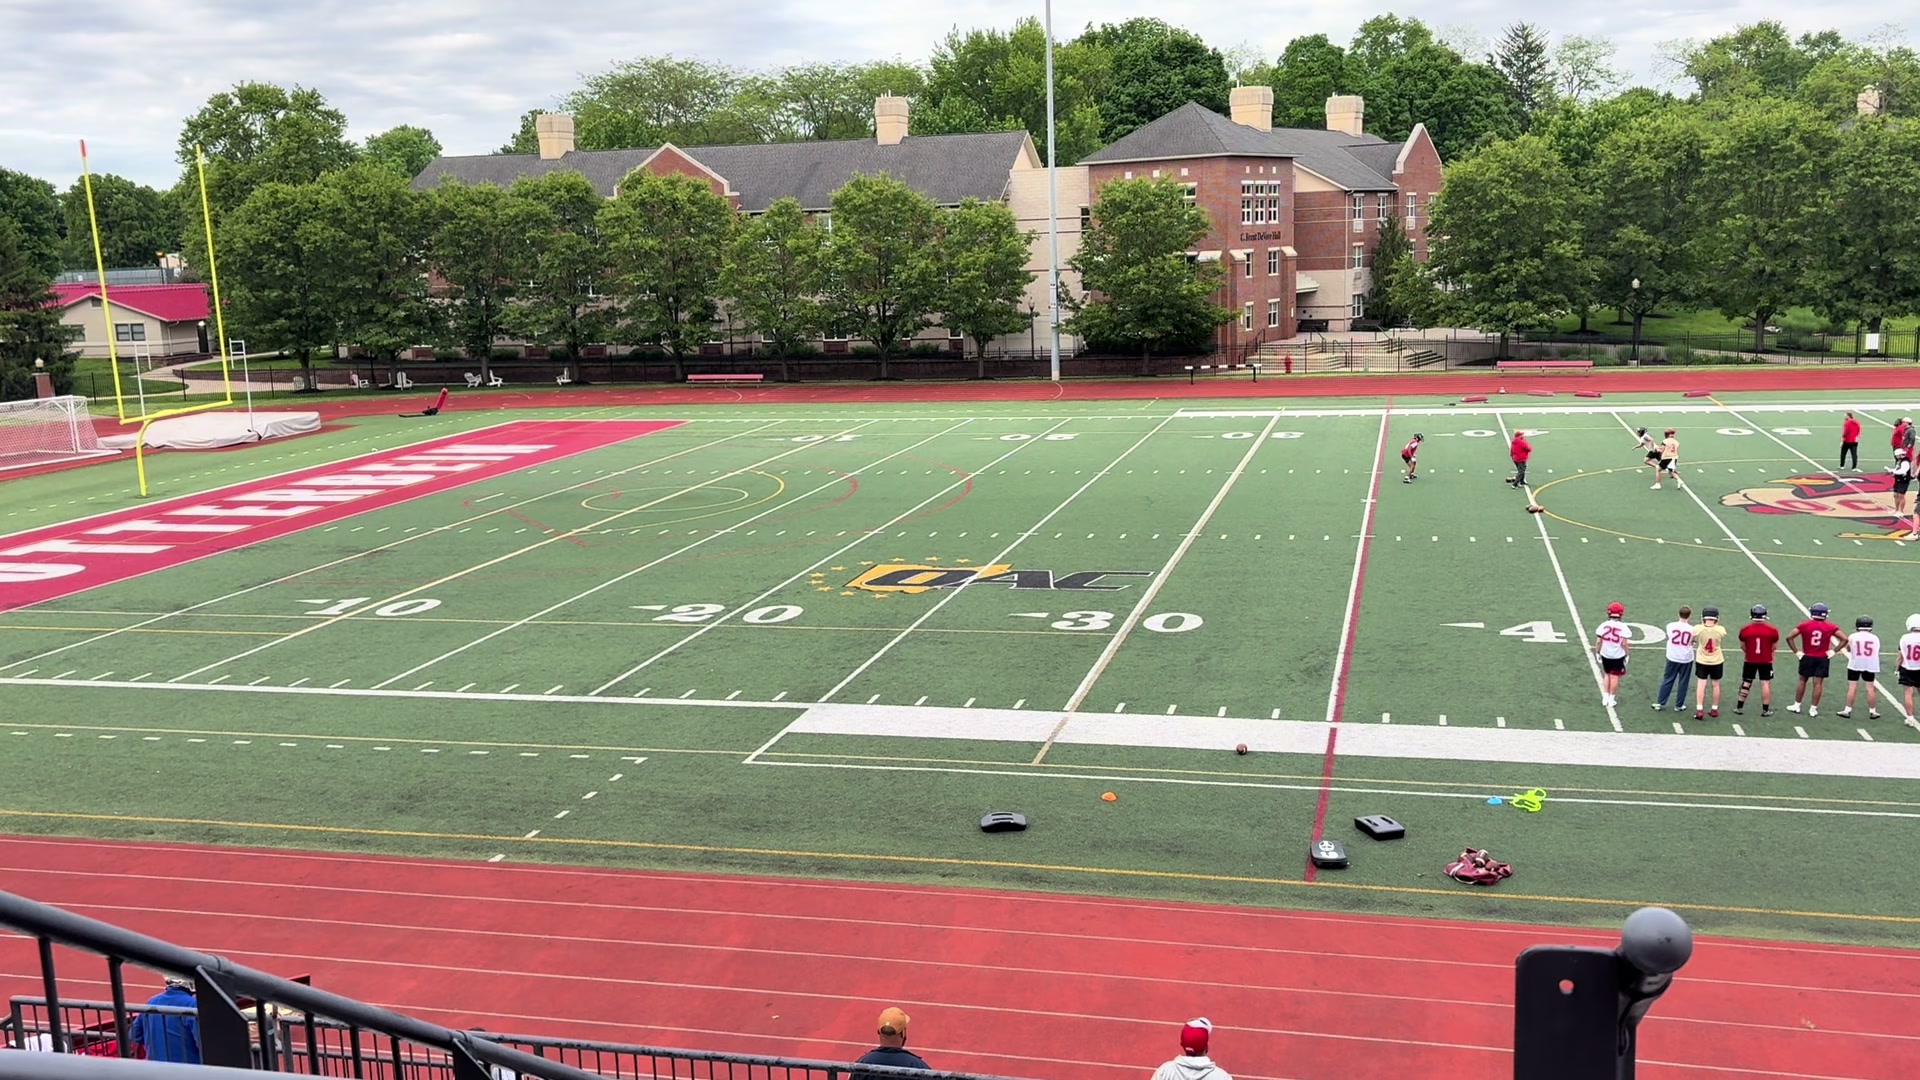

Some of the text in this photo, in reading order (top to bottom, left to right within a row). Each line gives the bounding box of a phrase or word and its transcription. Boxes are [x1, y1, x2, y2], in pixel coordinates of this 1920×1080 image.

[1272, 230, 1281, 240] Hall
[858, 567, 1155, 592] OAC
[1602, 625, 1622, 644] 25
[1671, 629, 1692, 646] 20
[1810, 630, 1823, 647] 2
[1704, 638, 1715, 654] 4
[1754, 637, 1762, 655] 1
[1855, 640, 1874, 657] 15
[1905, 643, 1920, 662] 16
